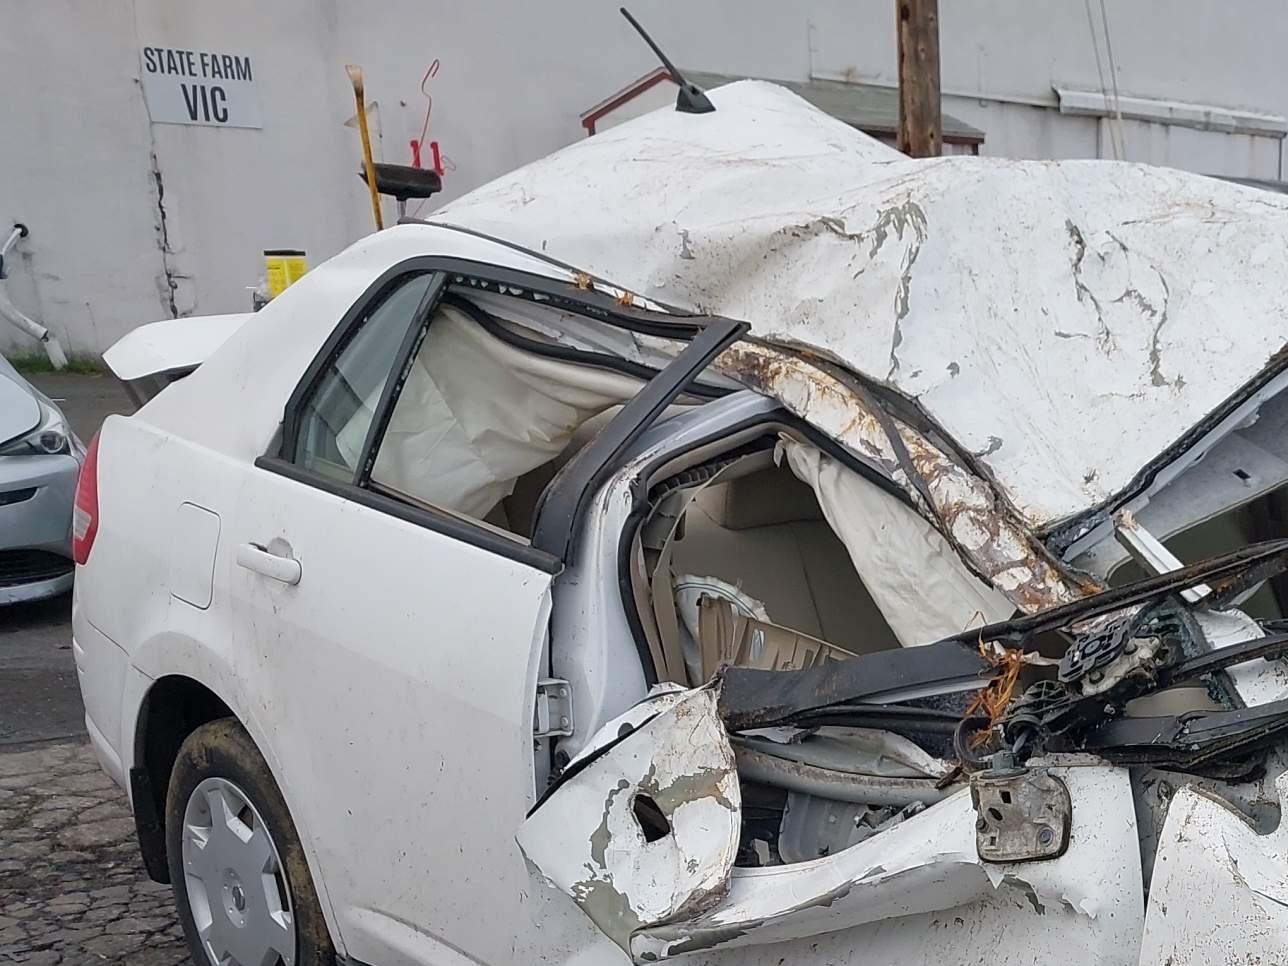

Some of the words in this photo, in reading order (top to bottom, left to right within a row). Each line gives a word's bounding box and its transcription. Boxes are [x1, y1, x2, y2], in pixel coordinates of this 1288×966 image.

[143, 46, 198, 77] STATE
[199, 52, 252, 81] FARM
[180, 83, 229, 123] VIC
